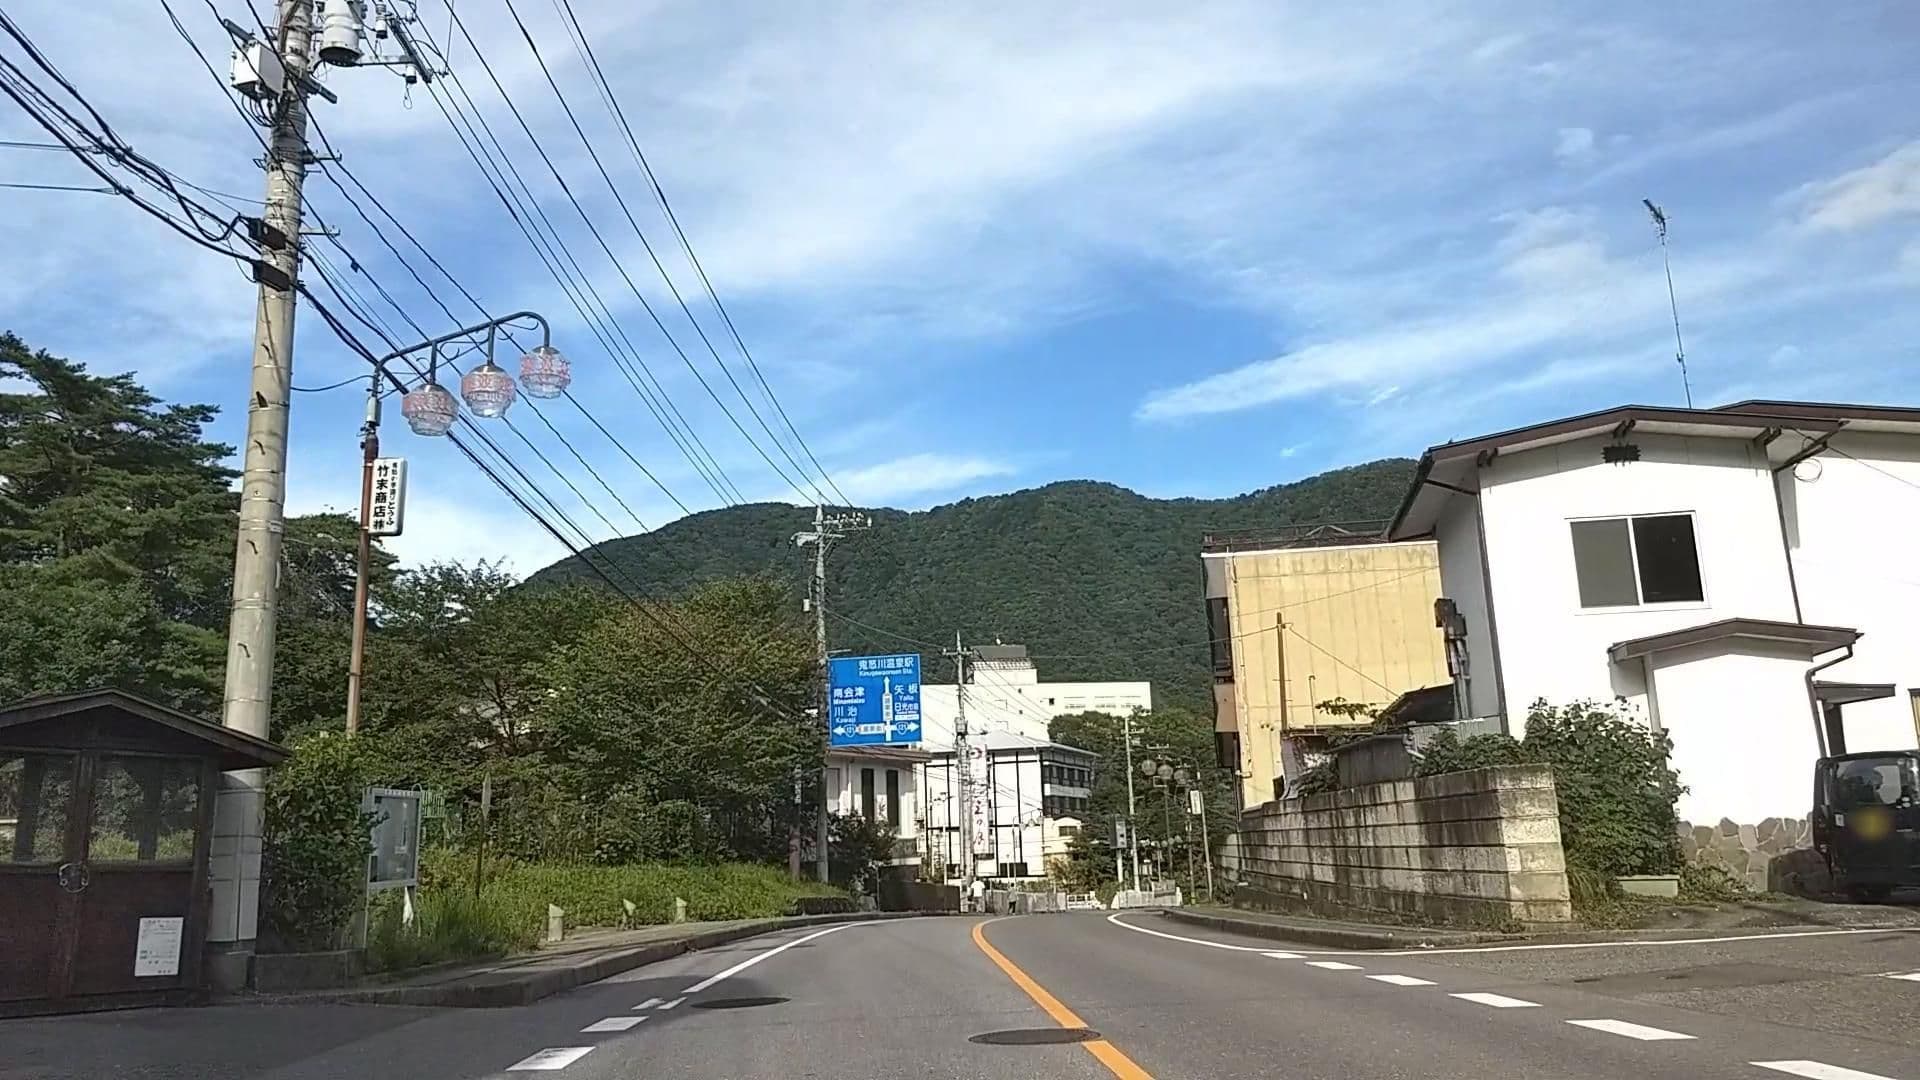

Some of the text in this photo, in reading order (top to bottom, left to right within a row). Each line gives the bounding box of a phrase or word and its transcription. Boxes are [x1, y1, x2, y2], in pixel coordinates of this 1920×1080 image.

[833, 687, 865, 698] 南会津
[834, 706, 857, 717] 川治
